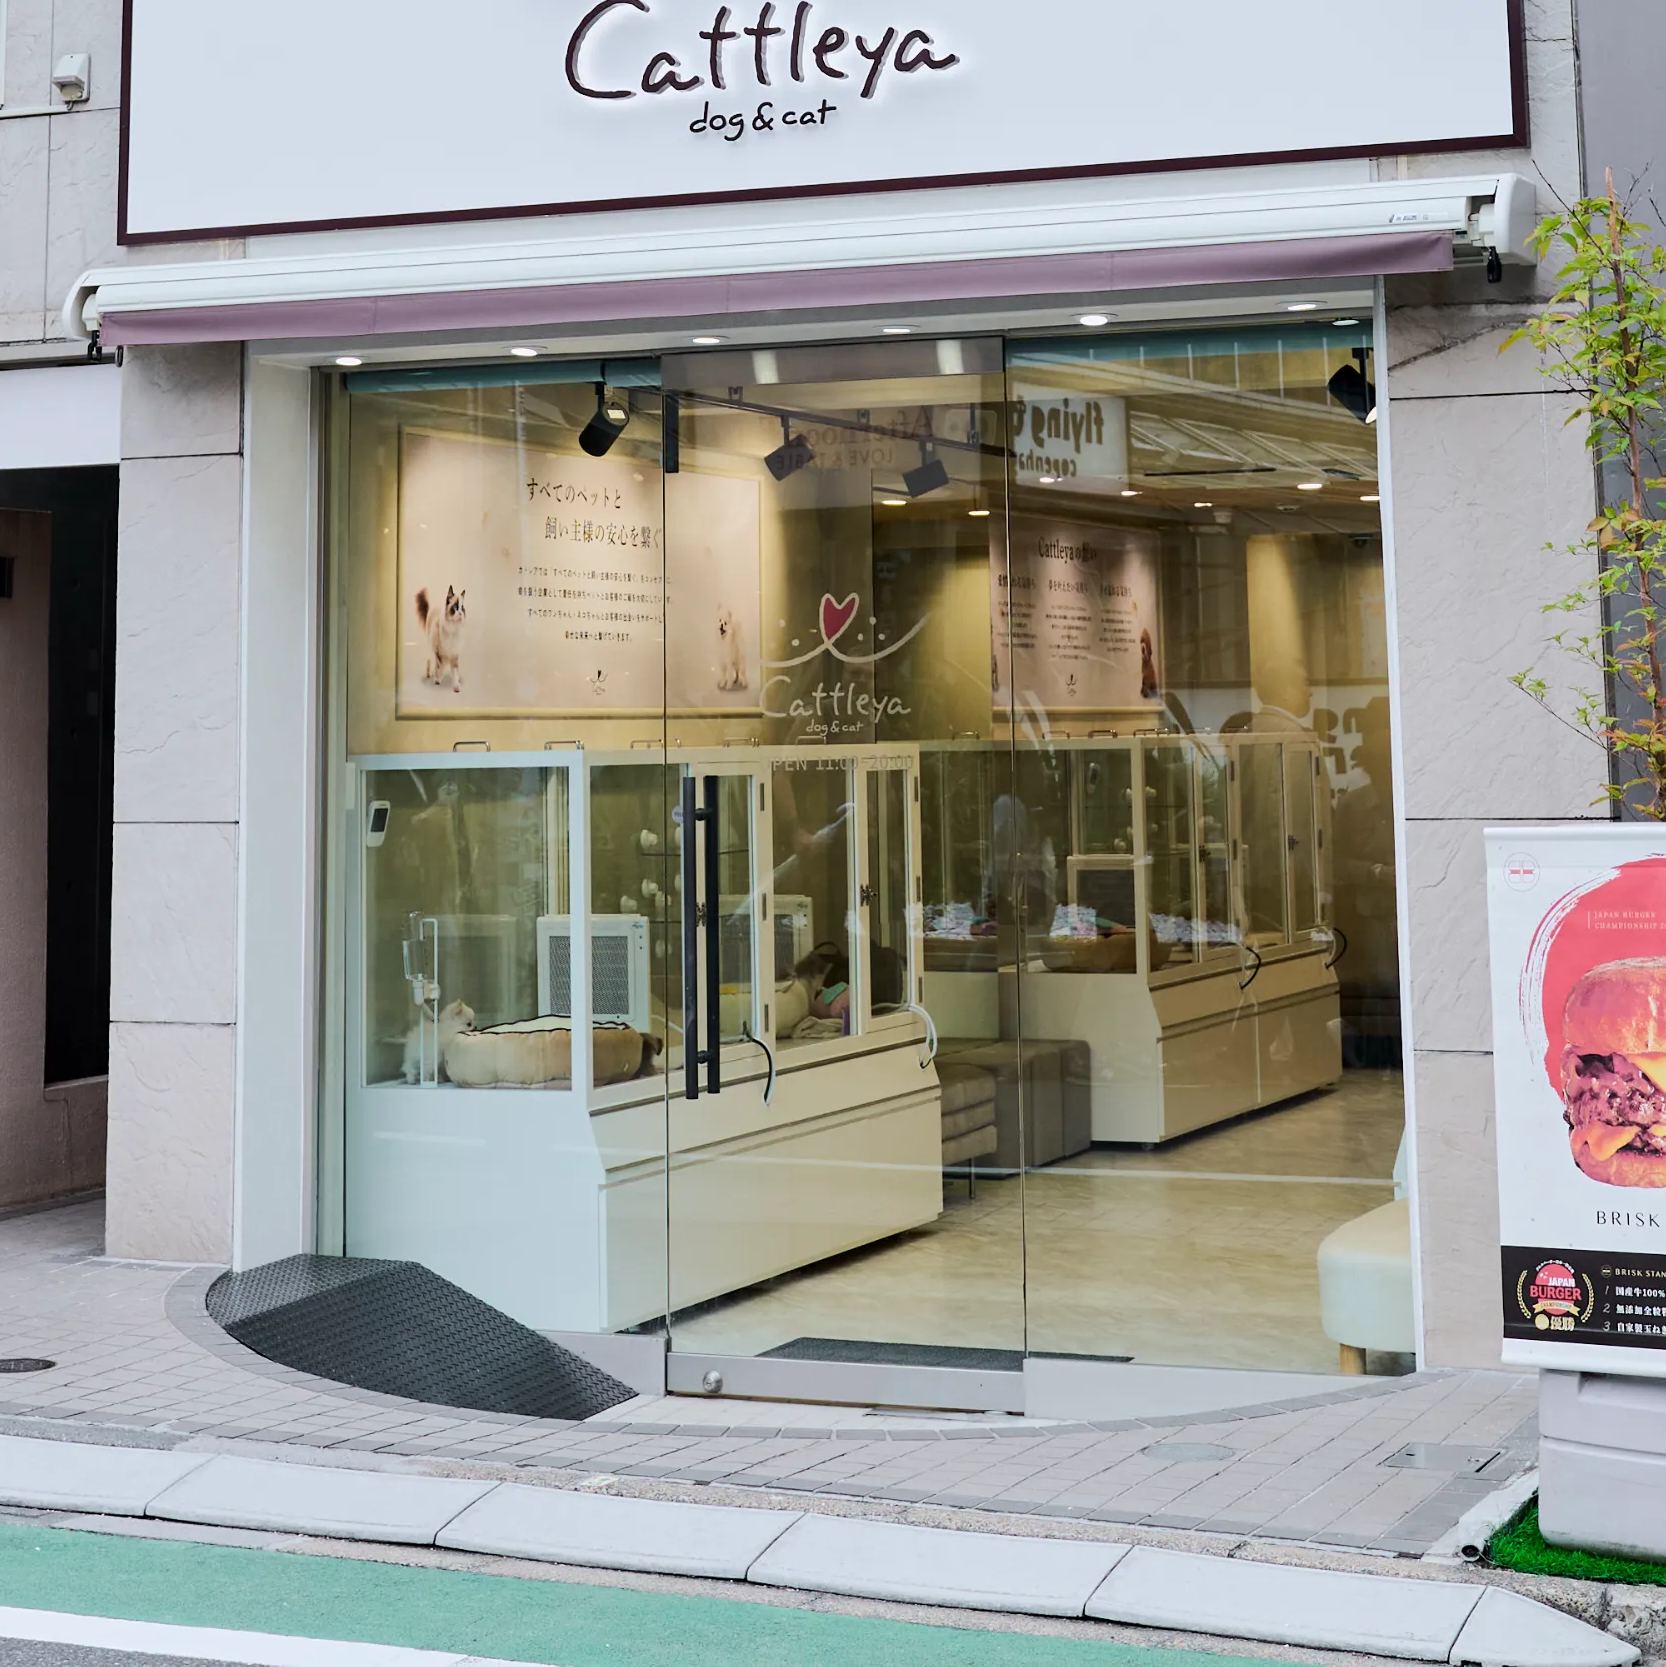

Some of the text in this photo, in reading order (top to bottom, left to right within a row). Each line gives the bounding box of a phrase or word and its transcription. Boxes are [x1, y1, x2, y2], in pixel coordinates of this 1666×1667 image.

[527, 478, 621, 509] すべてのペットと
[545, 516, 662, 549] 飼い主様の安心を繋ぐ
[760, 675, 911, 723] Cattleya
[1594, 921, 1658, 929] CHAMPIONSHIP
[1597, 1211, 1660, 1227] BRISK
[1615, 1268, 1643, 1277] BRISK
[1548, 1277, 1576, 1287] JAPAN
[1530, 1285, 1582, 1301] BURGER
[1603, 1304, 1611, 1313] 2
[1550, 1316, 1575, 1332] 優勝
[1603, 1321, 1611, 1331] 3
